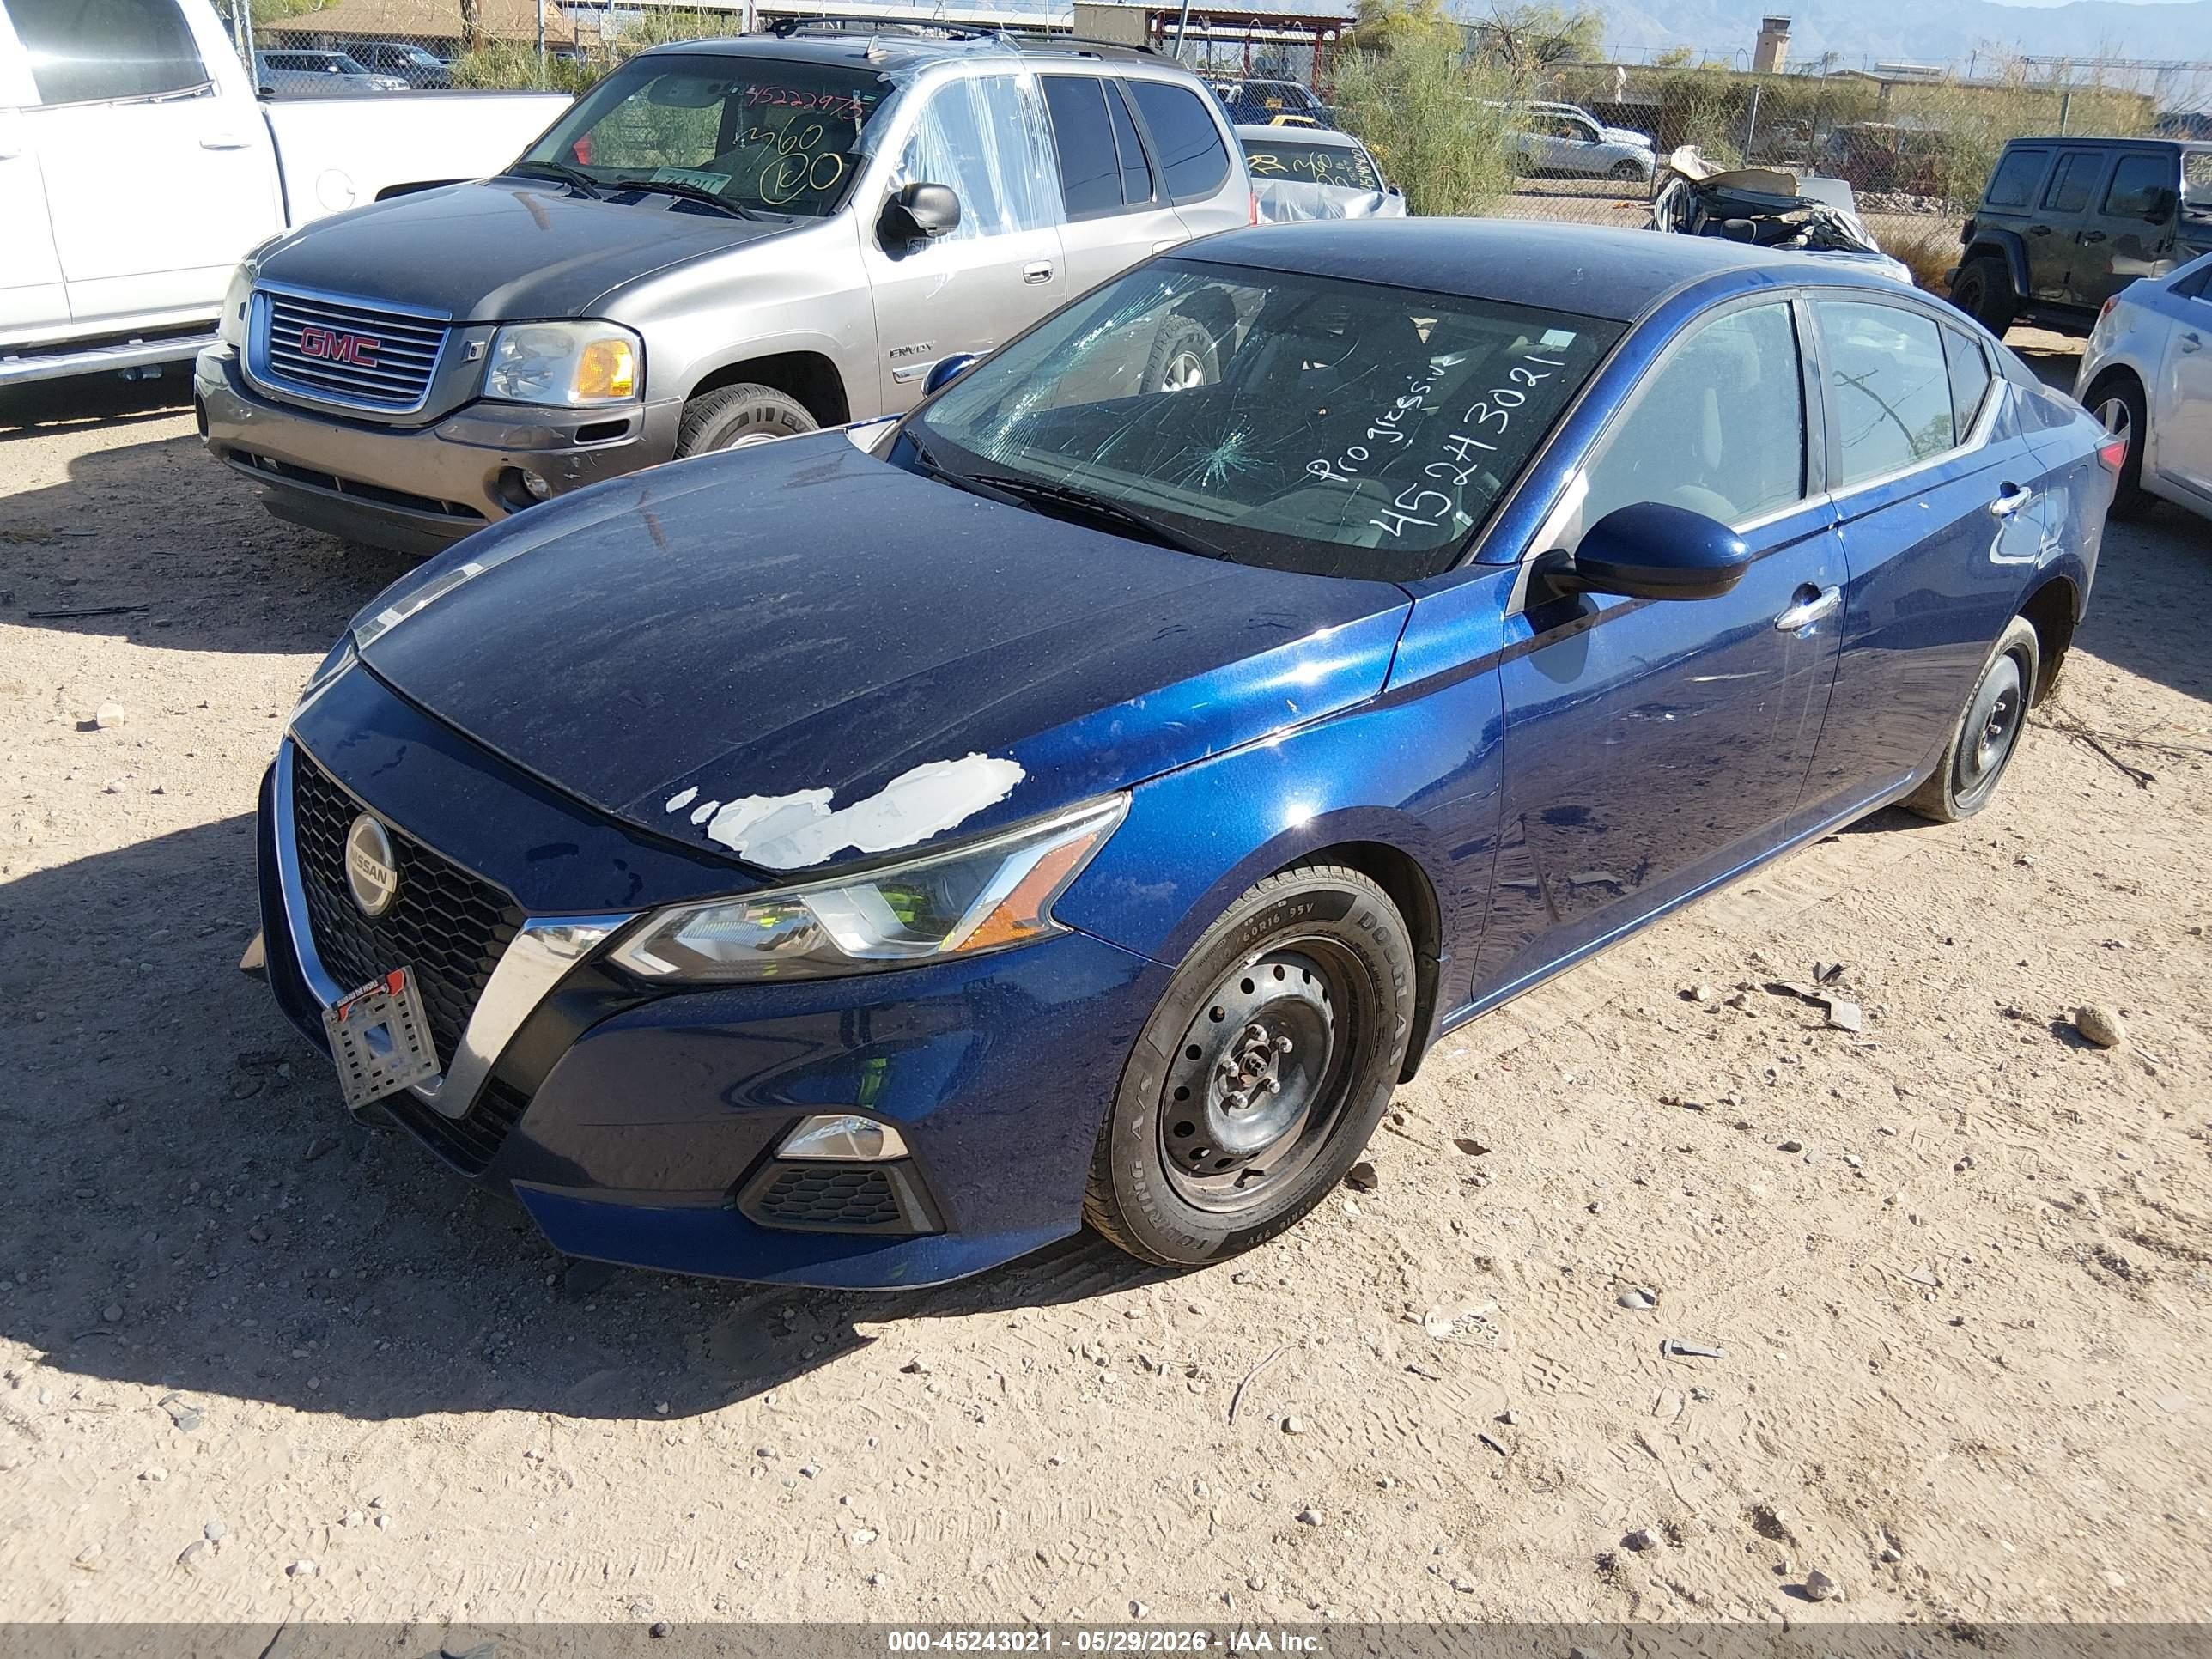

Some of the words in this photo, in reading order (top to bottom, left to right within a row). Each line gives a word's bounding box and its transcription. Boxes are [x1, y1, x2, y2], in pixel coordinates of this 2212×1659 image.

[301, 326, 381, 368] GMC
[890, 340, 934, 358] ENVOY
[1369, 355, 1565, 538] 45243021
[1289, 902, 1314, 918] 95V
[1130, 1160, 1209, 1251] TOURING
